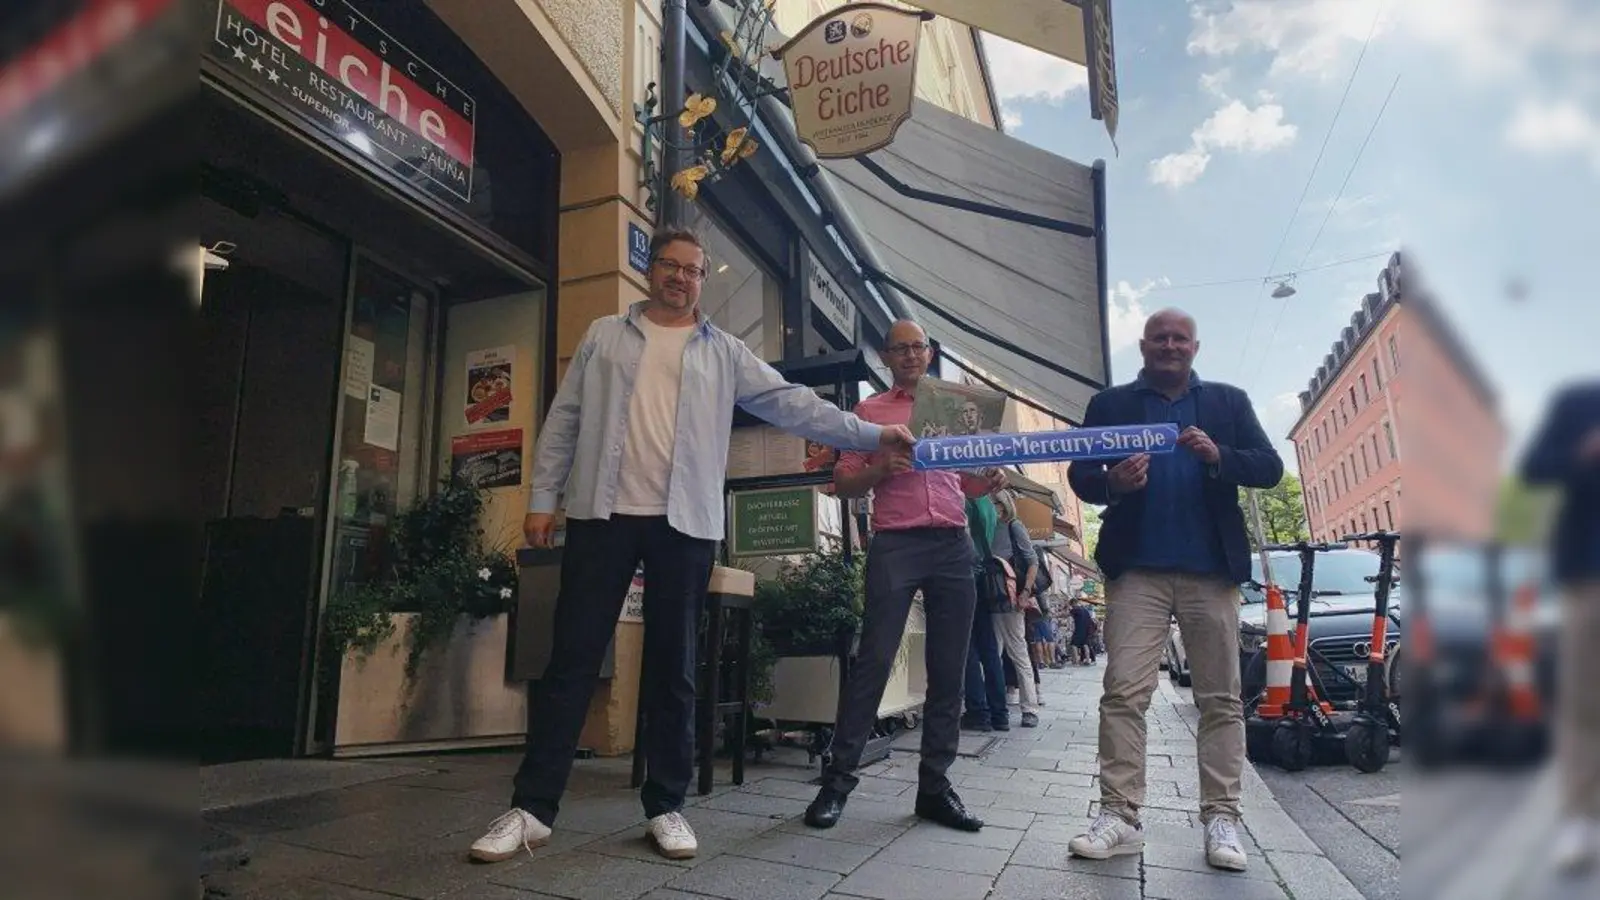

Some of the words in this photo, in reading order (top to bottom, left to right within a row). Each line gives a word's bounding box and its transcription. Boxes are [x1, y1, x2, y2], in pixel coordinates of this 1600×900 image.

[266, 2, 446, 150] eiche
[793, 38, 911, 90] Deutsche
[227, 15, 290, 70] HOTEL
[309, 72, 409, 148] RESTAURANT
[421, 146, 467, 184] SAUNA
[291, 86, 350, 129] SUPERIOR
[818, 81, 890, 120] Eiche
[929, 429, 1166, 461] Freddie-Mercury-Straße
